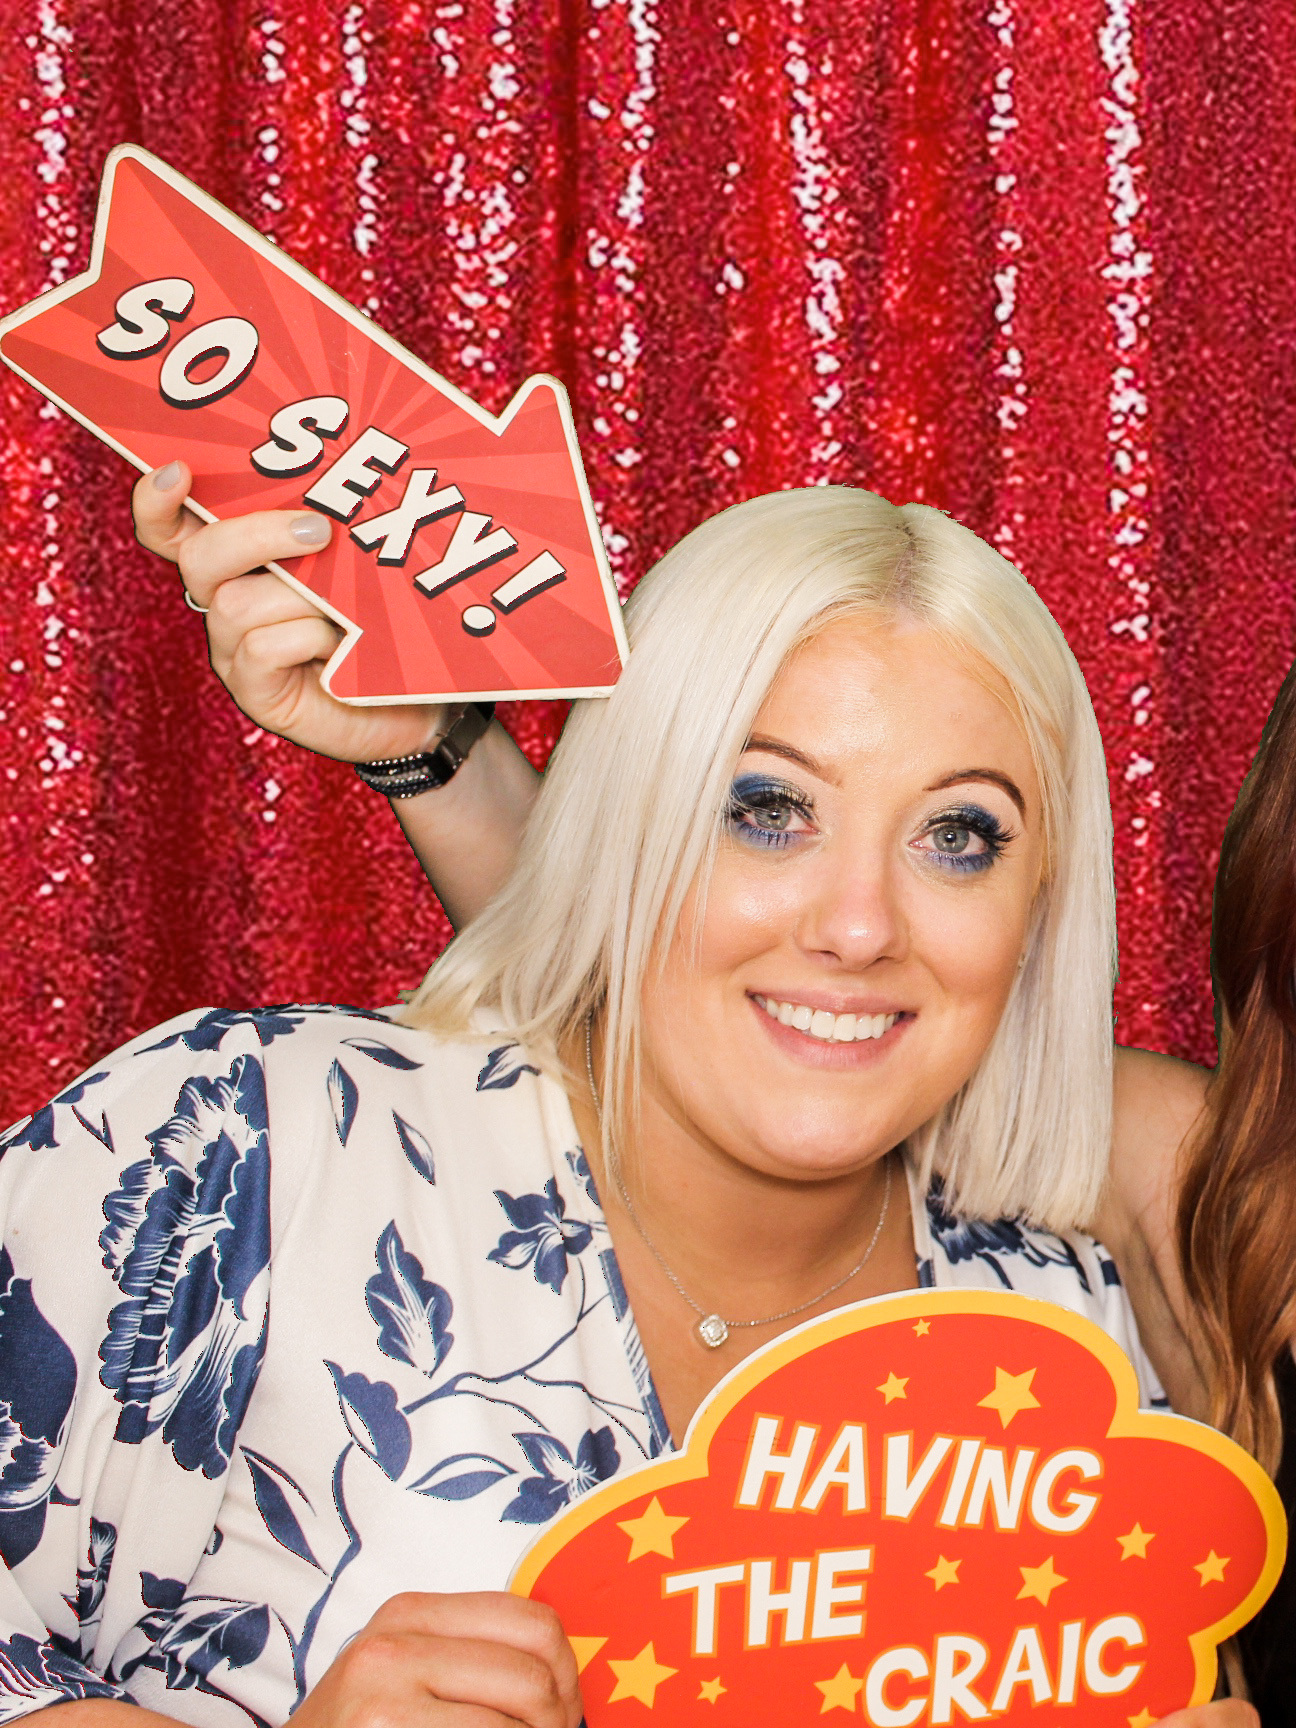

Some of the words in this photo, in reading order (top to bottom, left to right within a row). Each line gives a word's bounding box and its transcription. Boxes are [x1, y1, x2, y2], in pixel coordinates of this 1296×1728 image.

[97, 277, 259, 409] SO
[250, 396, 567, 636] SEXY!
[734, 1413, 1103, 1534] HAVING
[661, 1545, 875, 1658] THE
[863, 1613, 1147, 1727] CRAIC
